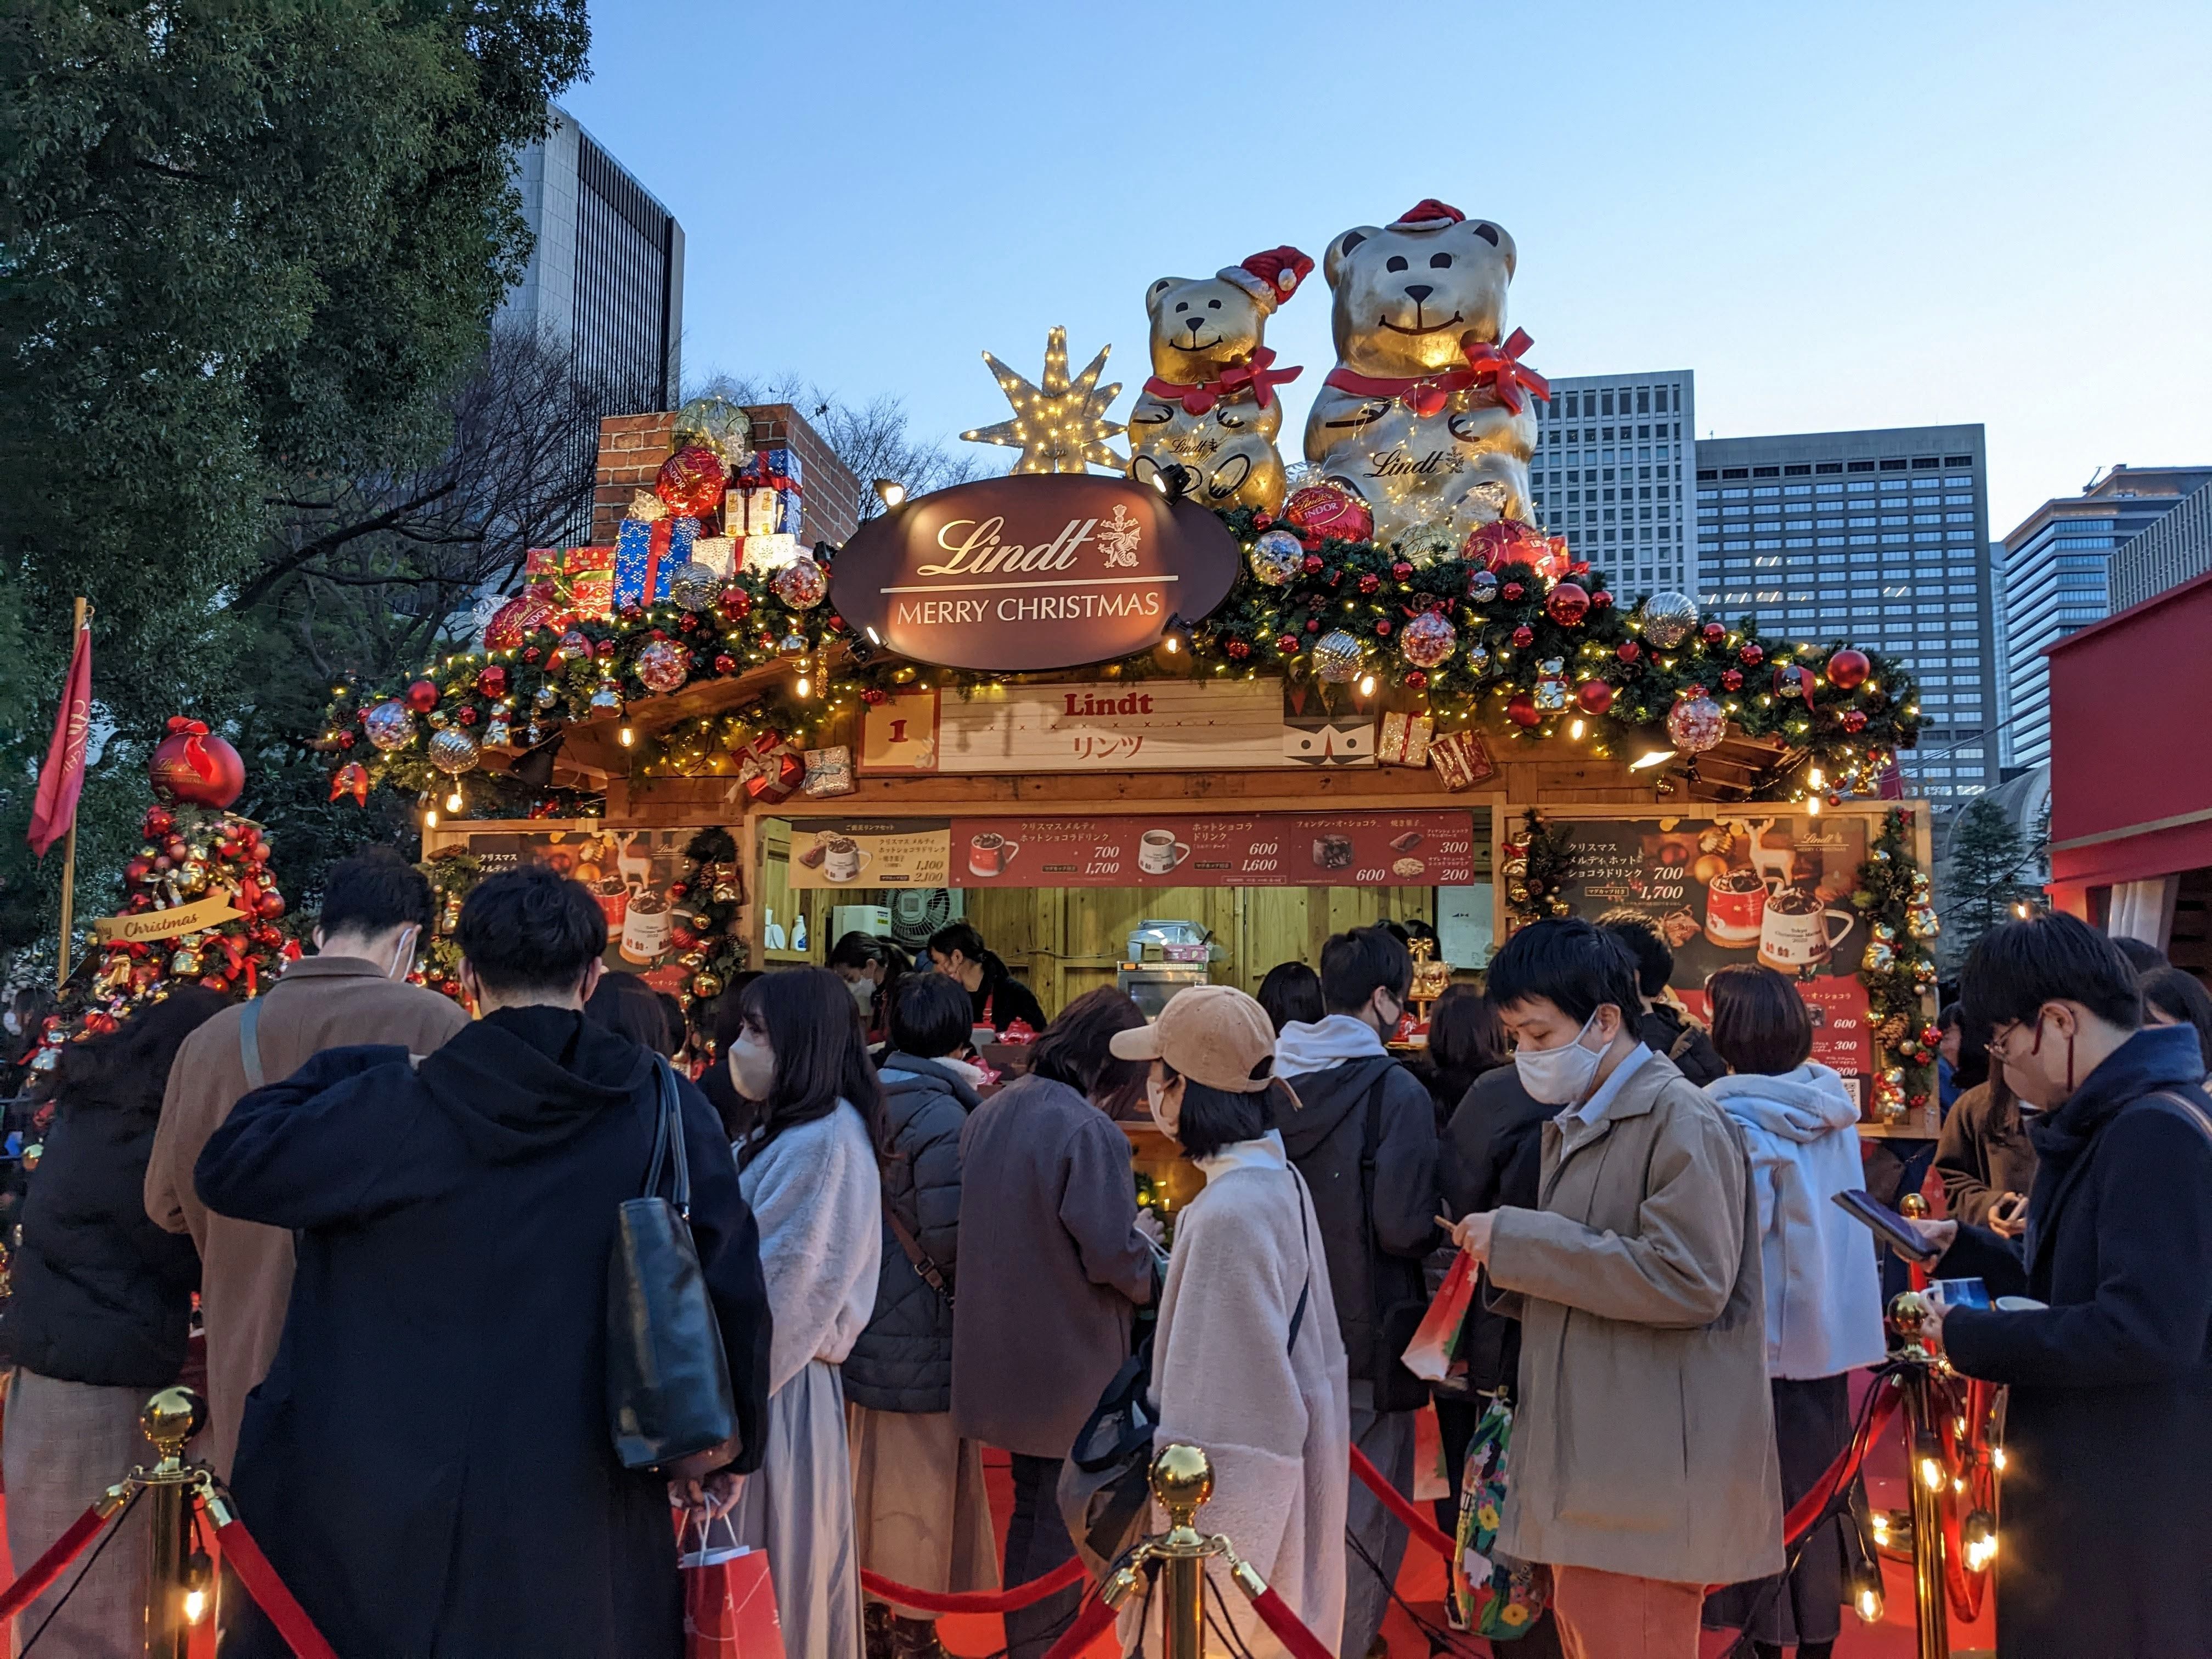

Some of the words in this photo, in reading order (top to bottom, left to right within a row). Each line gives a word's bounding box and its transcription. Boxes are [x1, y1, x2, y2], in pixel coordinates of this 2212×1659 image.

[1167, 439, 1207, 453] Lindt
[1363, 449, 1444, 477] Lindt
[1300, 503, 1339, 521] LINDOR
[917, 516, 1098, 575] Lindt
[898, 600, 989, 625] MERRY
[997, 592, 1159, 621] CHRISTMAS
[1064, 692, 1153, 716] Lindt
[888, 720, 909, 742] 1
[1074, 735, 1143, 760] リンツ
[1193, 822, 1252, 831] ホットショコラ
[1020, 833, 1109, 842] ホットショコラドリンク
[1194, 833, 1227, 841] ドリンク
[1094, 846, 1119, 858] 700
[1250, 843, 1278, 855] 600
[1440, 842, 1468, 853] 300
[1568, 843, 1617, 851] クリスマス
[478, 854, 517, 862] クリスマス
[1609, 855, 1636, 865] ホット
[916, 860, 944, 870] 1,100
[1085, 862, 1119, 874] 1,700
[1242, 859, 1277, 872] 1,600
[1356, 869, 1385, 881] 600
[1440, 869, 1469, 881] 200
[1568, 868, 1643, 878] ショコラドリンク
[1654, 867, 1684, 880] 700
[1639, 885, 1684, 900] 1,700
[124, 913, 199, 938] Christmas
[1834, 1019, 1857, 1029] 600
[1834, 1041, 1857, 1050] 300
[1837, 1067, 1858, 1076] 200
